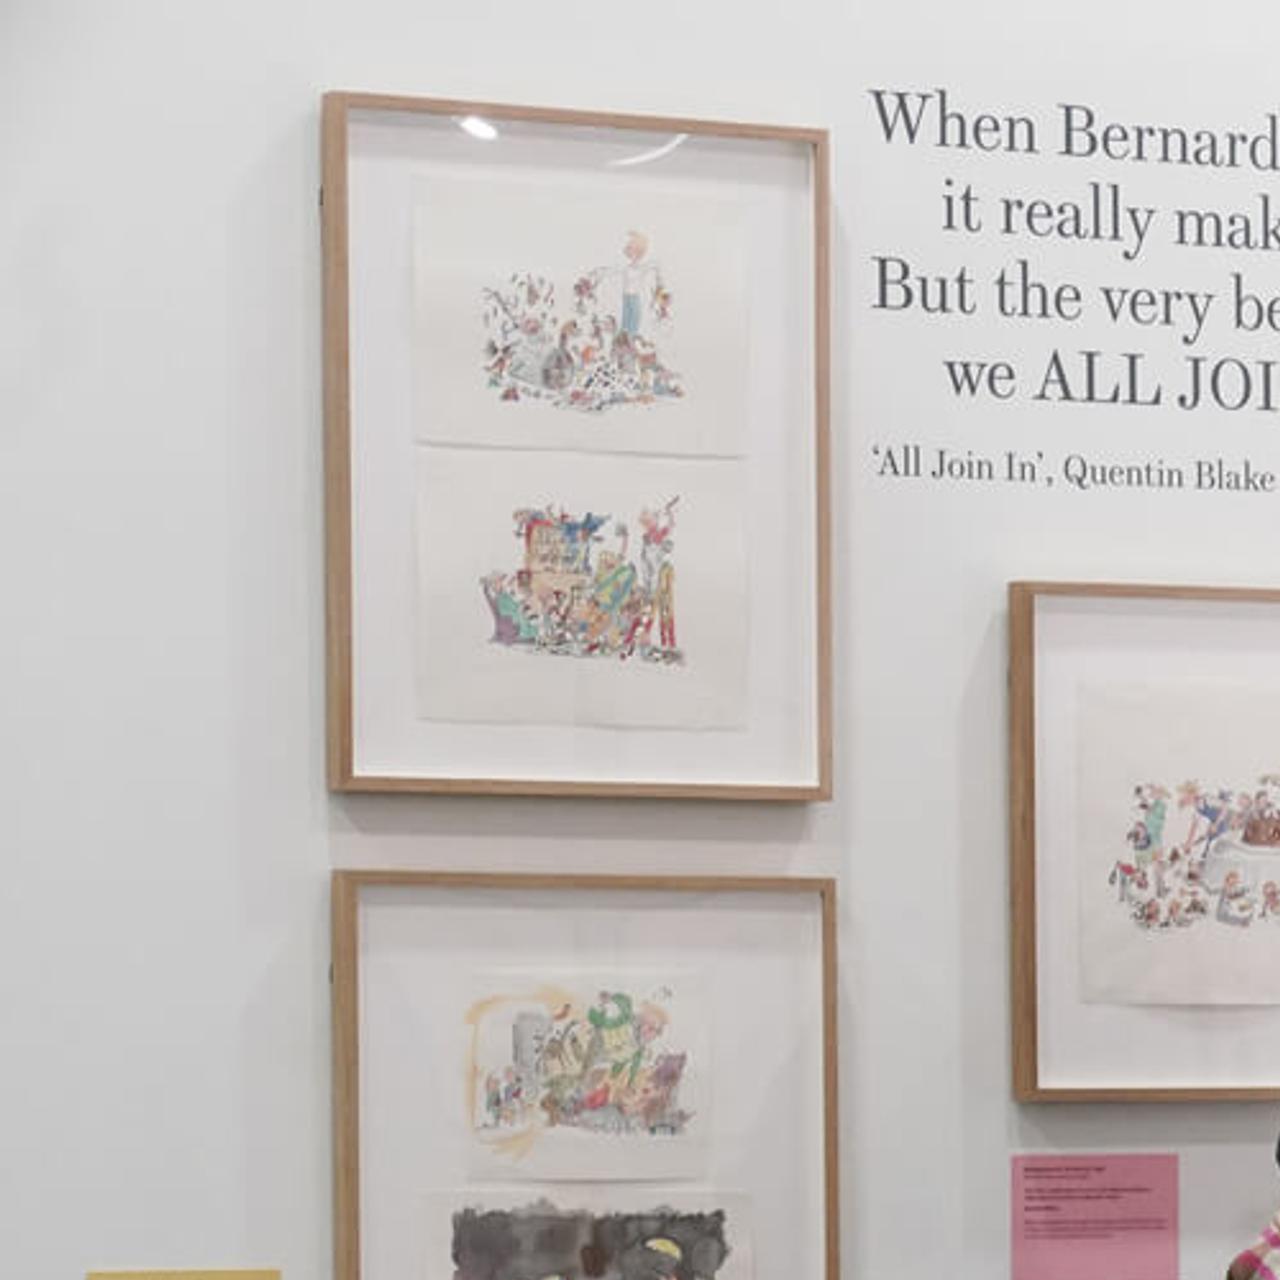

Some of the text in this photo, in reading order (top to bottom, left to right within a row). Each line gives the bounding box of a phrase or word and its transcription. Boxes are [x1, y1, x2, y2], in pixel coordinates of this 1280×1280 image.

[867, 88, 1040, 154] When
[942, 178, 982, 233] it
[1000, 182, 1156, 261] really
[871, 256, 976, 315] But
[994, 259, 1082, 321] the
[1099, 287, 1216, 346] very
[943, 361, 1015, 400] we
[1032, 349, 1162, 406] ALL
[931, 449, 994, 480] Join
[1063, 455, 1184, 490] Quentin
[1195, 458, 1275, 492] Blake
